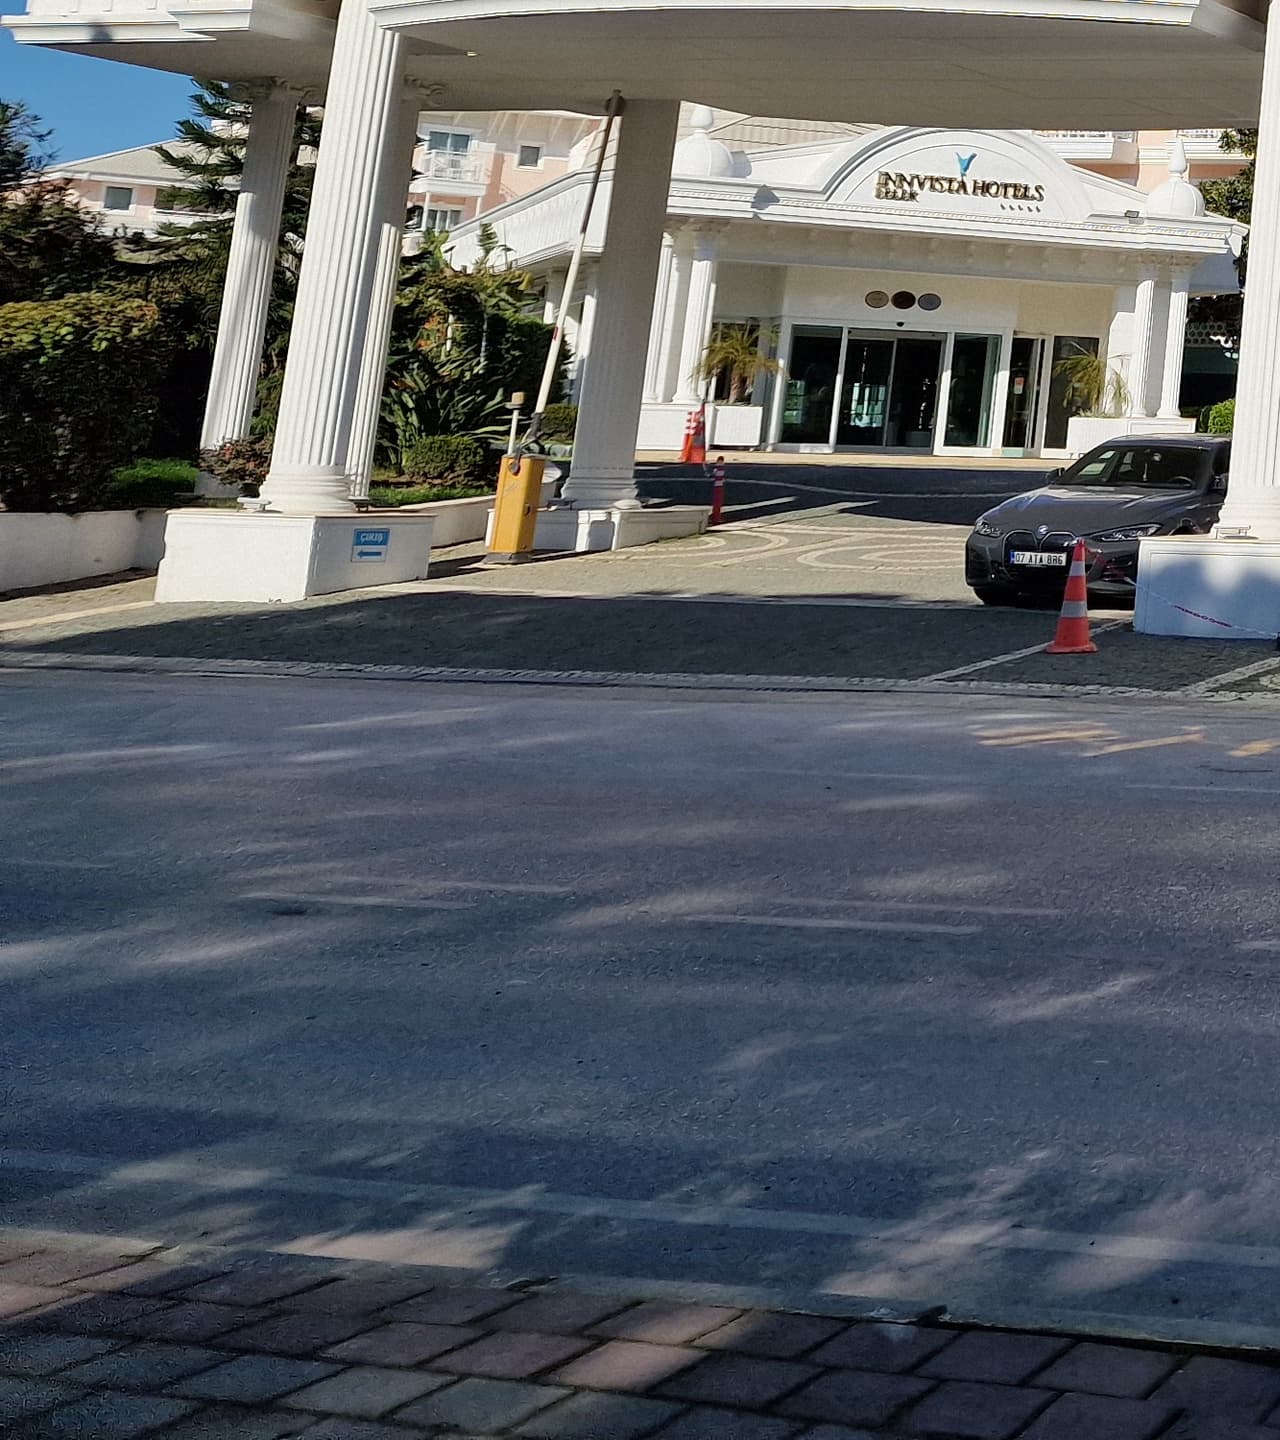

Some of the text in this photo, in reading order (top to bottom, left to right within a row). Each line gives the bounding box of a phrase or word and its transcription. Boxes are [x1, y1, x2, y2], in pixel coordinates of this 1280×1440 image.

[877, 170, 1046, 202] INNVISTA HOTELS
[1015, 553, 1025, 563] 07
[1028, 554, 1043, 564] ATA
